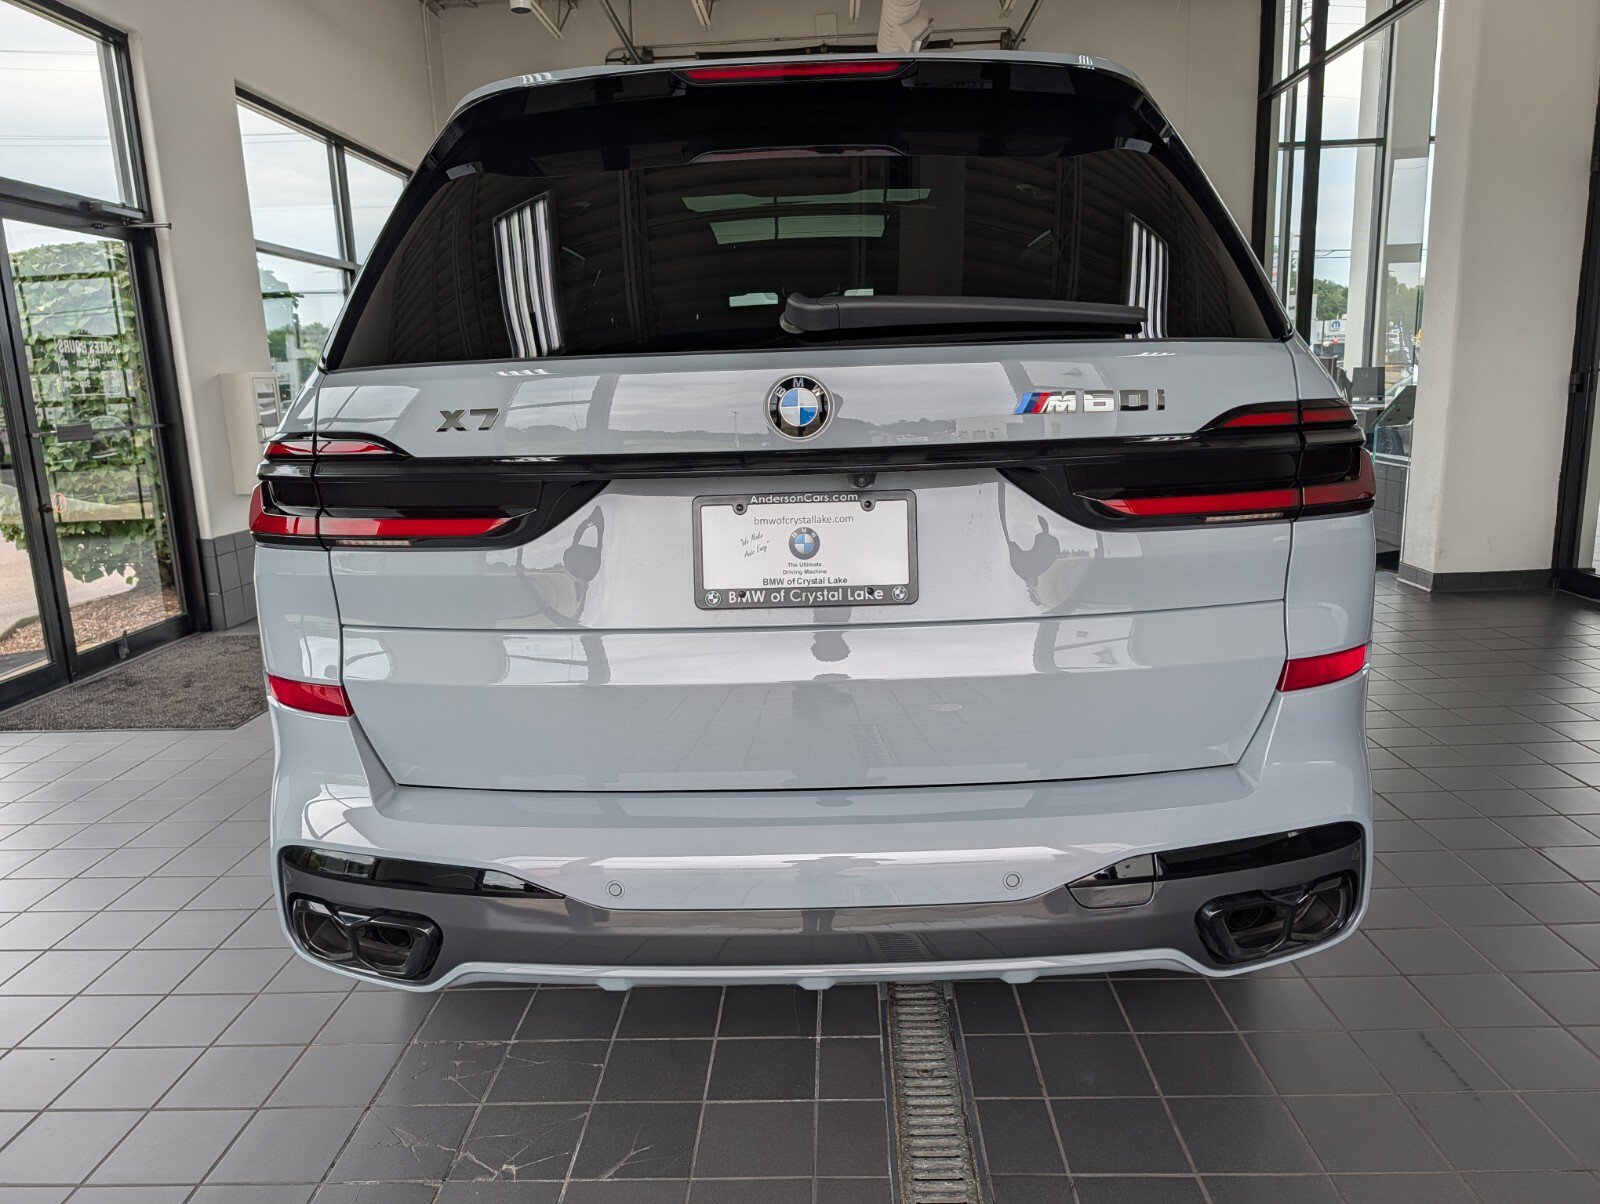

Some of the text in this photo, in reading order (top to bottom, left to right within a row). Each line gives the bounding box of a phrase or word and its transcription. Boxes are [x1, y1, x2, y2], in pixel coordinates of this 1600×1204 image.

[773, 377, 825, 398] BMW
[435, 407, 500, 433] X7
[750, 493, 859, 504] AndersonCars.com
[753, 514, 854, 526] bmwofcrystallake.com
[762, 576, 848, 586] BMW of Crystal Lake
[728, 589, 766, 604] BMW
[770, 588, 786, 602] of
[789, 588, 842, 605] Crystal
[847, 586, 884, 601] Lake
